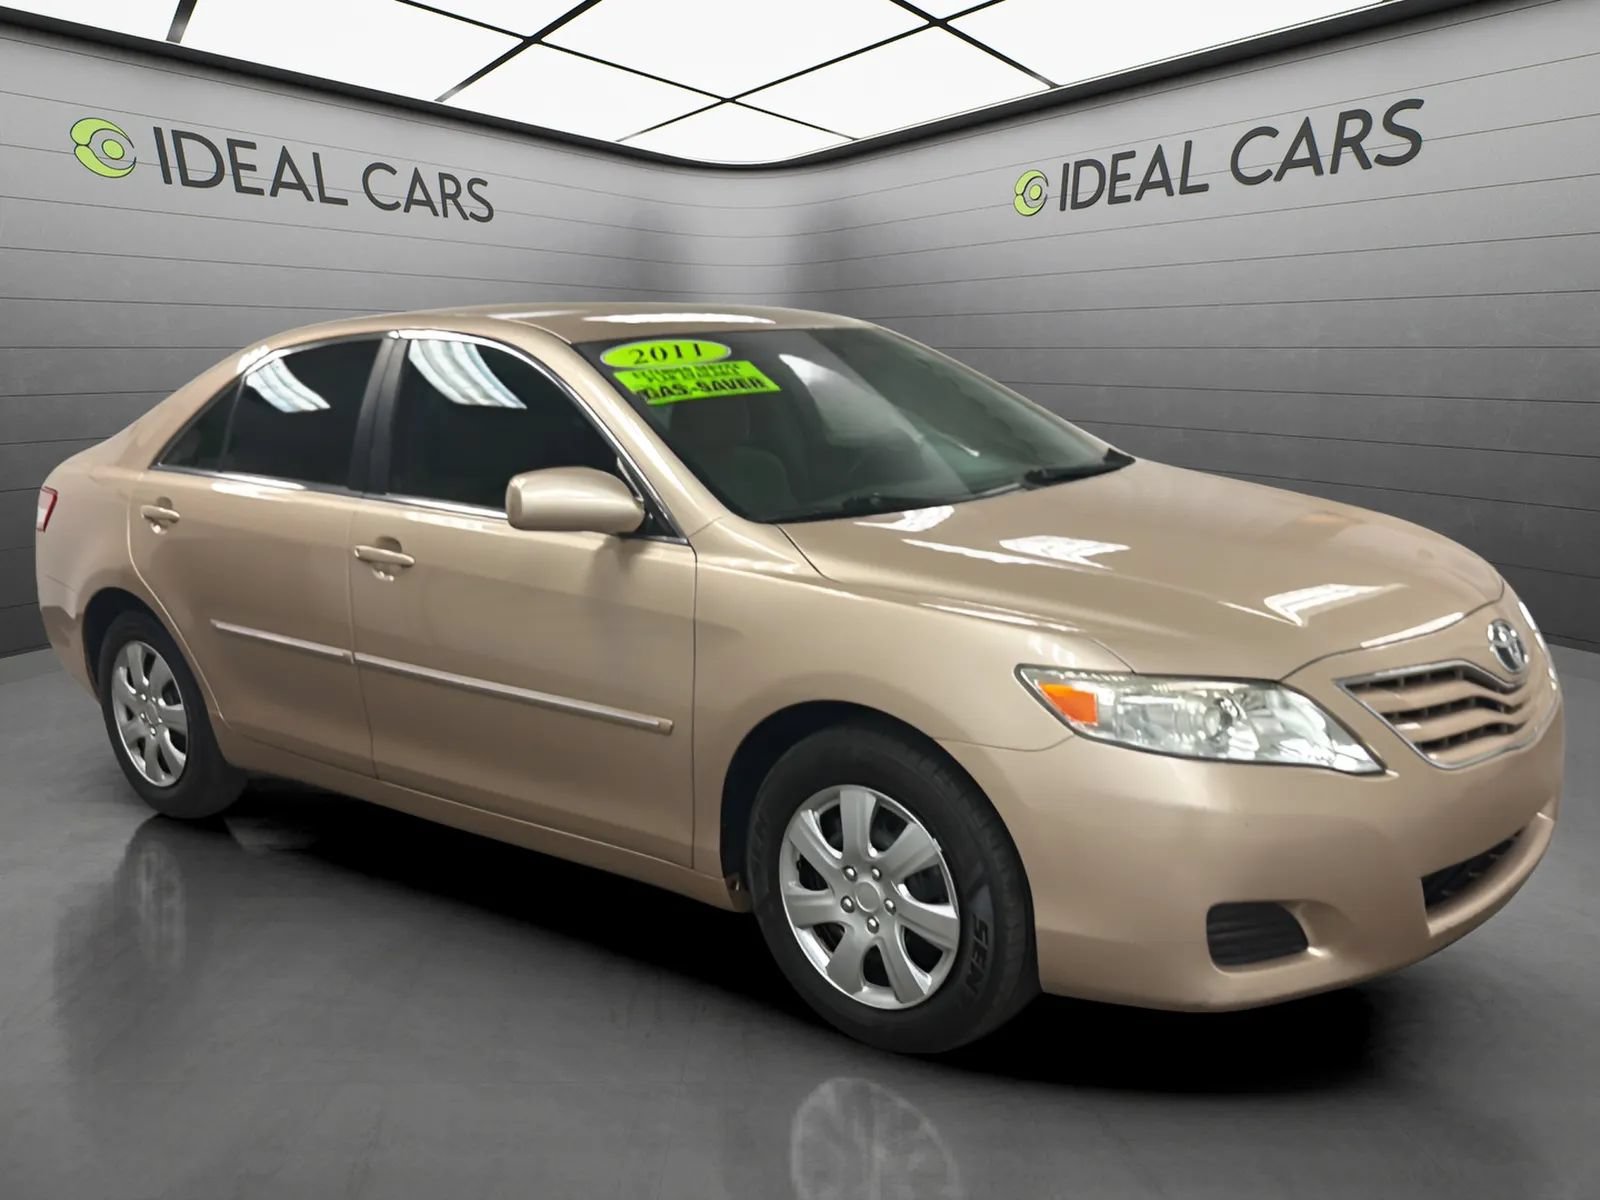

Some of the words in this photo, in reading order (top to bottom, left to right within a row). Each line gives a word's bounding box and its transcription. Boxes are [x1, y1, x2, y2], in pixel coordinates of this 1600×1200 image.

[152, 126, 349, 206] IDEAL
[362, 161, 495, 223] CARS
[1059, 140, 1209, 212] IDEAL
[1230, 98, 1425, 187] CARS
[628, 343, 702, 365] 2011
